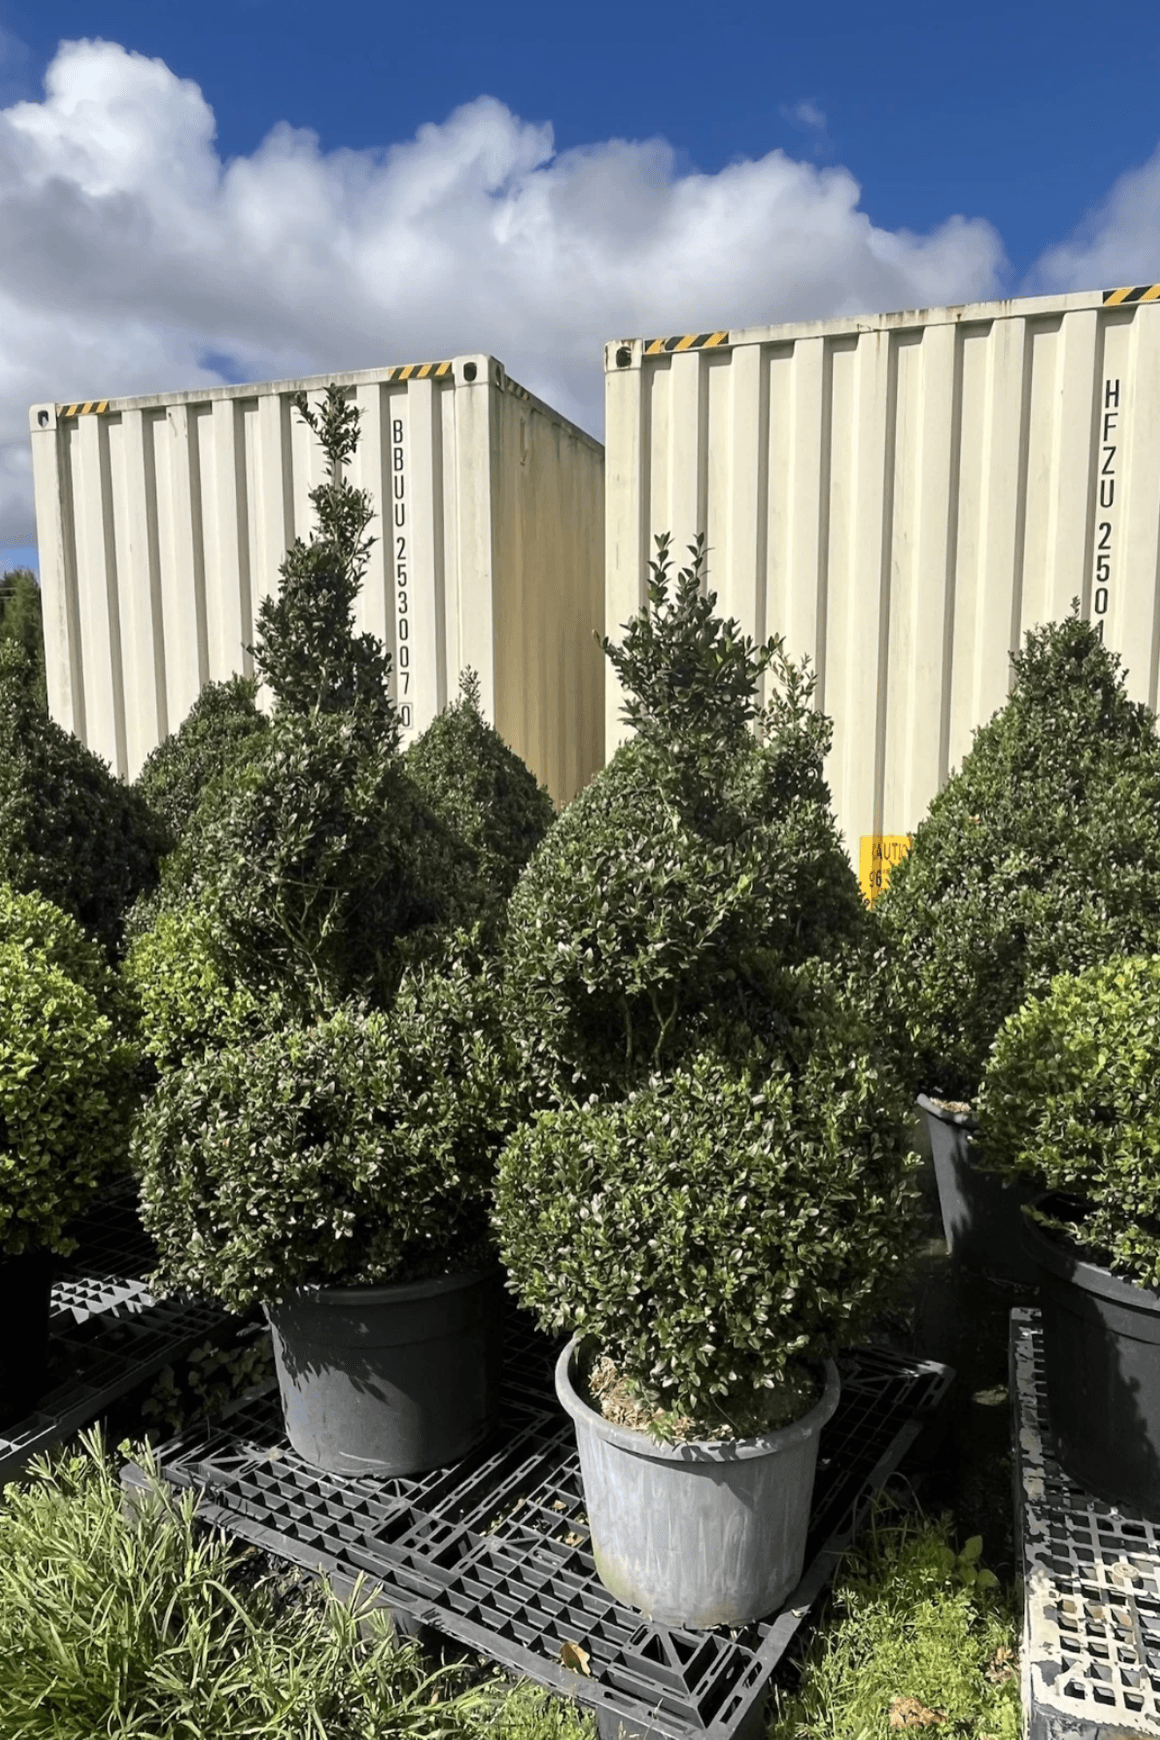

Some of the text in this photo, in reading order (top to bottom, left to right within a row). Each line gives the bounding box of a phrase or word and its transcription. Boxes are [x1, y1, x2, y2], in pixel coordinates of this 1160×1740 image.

[393, 419, 405, 527] BBUU
[1099, 379, 1120, 508] HFZU
[396, 536, 410, 695] 253007
